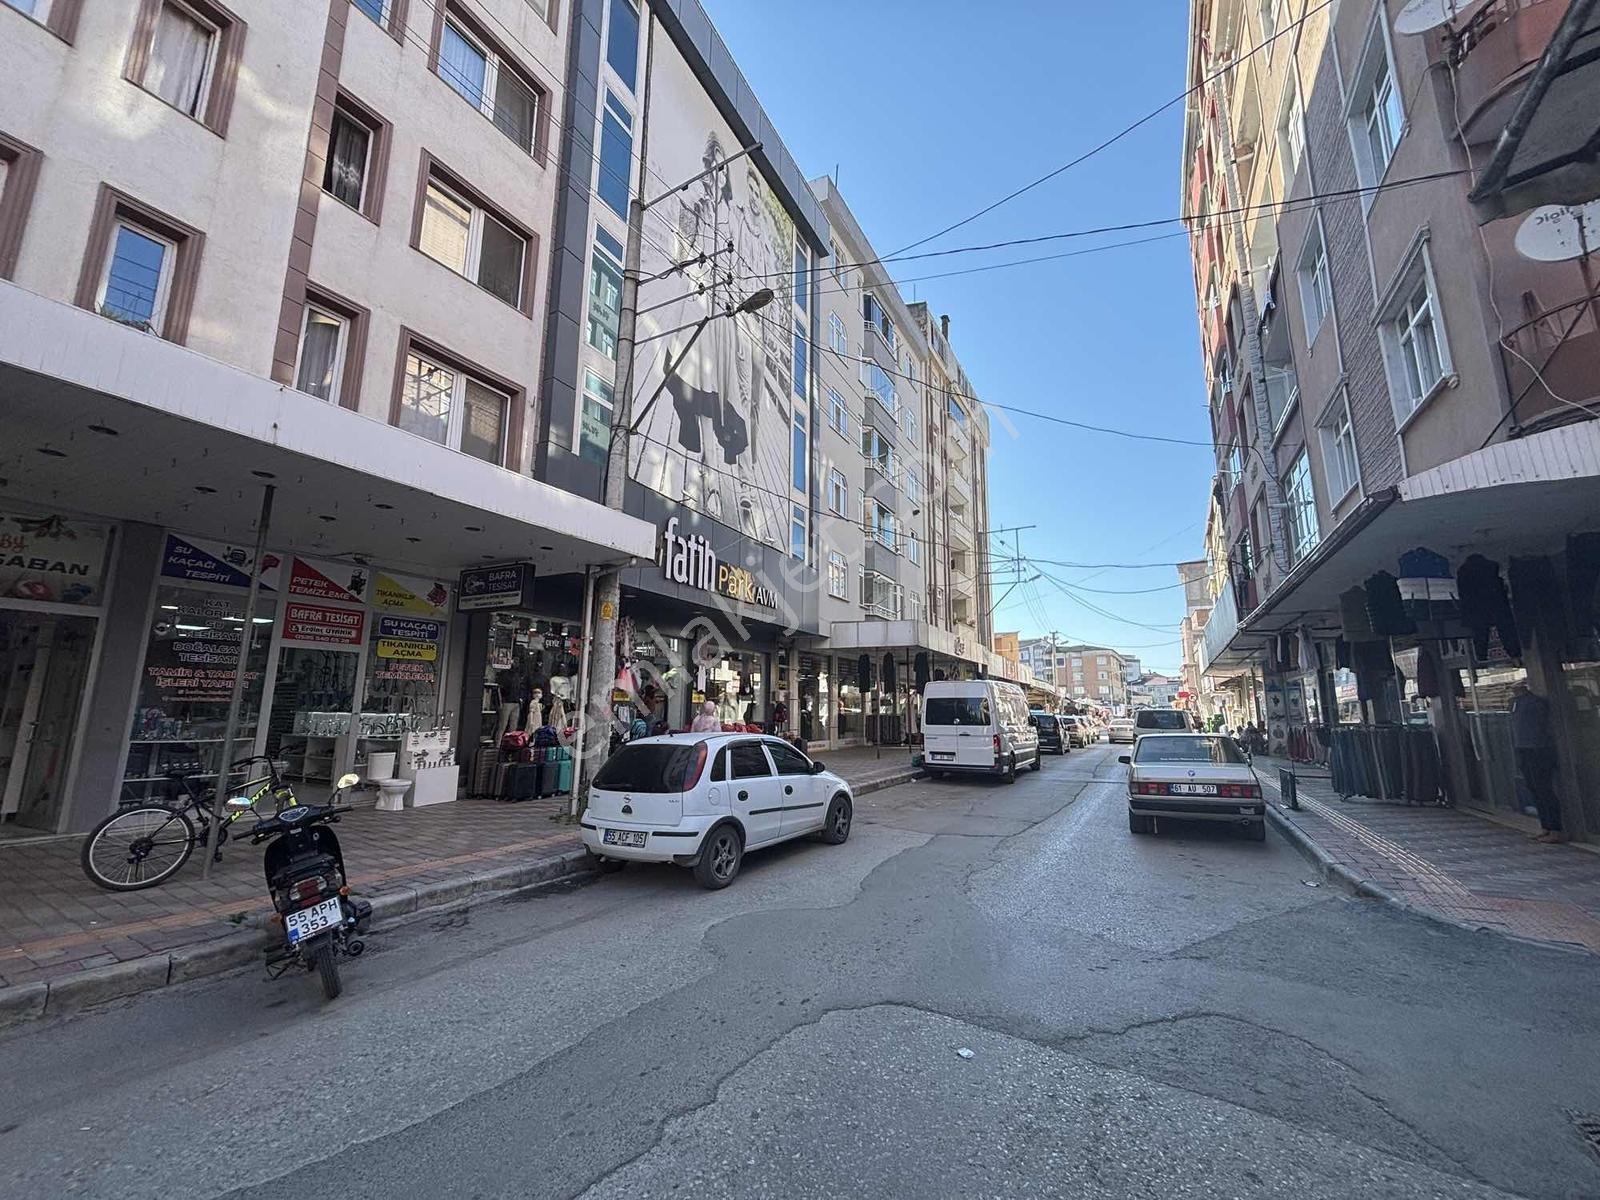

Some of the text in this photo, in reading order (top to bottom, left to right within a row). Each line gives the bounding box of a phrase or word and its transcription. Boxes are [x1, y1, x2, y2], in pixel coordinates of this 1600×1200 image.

[173, 545, 193, 555] SU
[664, 516, 778, 609] fatih Park AVM
[185, 569, 231, 582] TESPİTİ
[488, 570, 517, 581] BAFRA
[292, 576, 328, 588] PETEK
[289, 585, 350, 600] TEMİZLEME
[204, 599, 231, 608] KAT
[290, 608, 360, 625] BAFRA TESİSAT
[384, 619, 398, 627] SU
[381, 640, 436, 651] TIKANIKLIK
[179, 653, 239, 664] TESİSATI
[392, 649, 423, 658] AÇMA
[148, 666, 257, 679] TAMİR & TADİAT
[156, 676, 250, 689] İŞLERİ YAPIR
[1202, 785, 1215, 793] 507
[633, 832, 643, 844] 105
[288, 899, 337, 927] 55 APH
[302, 915, 329, 934] 353
